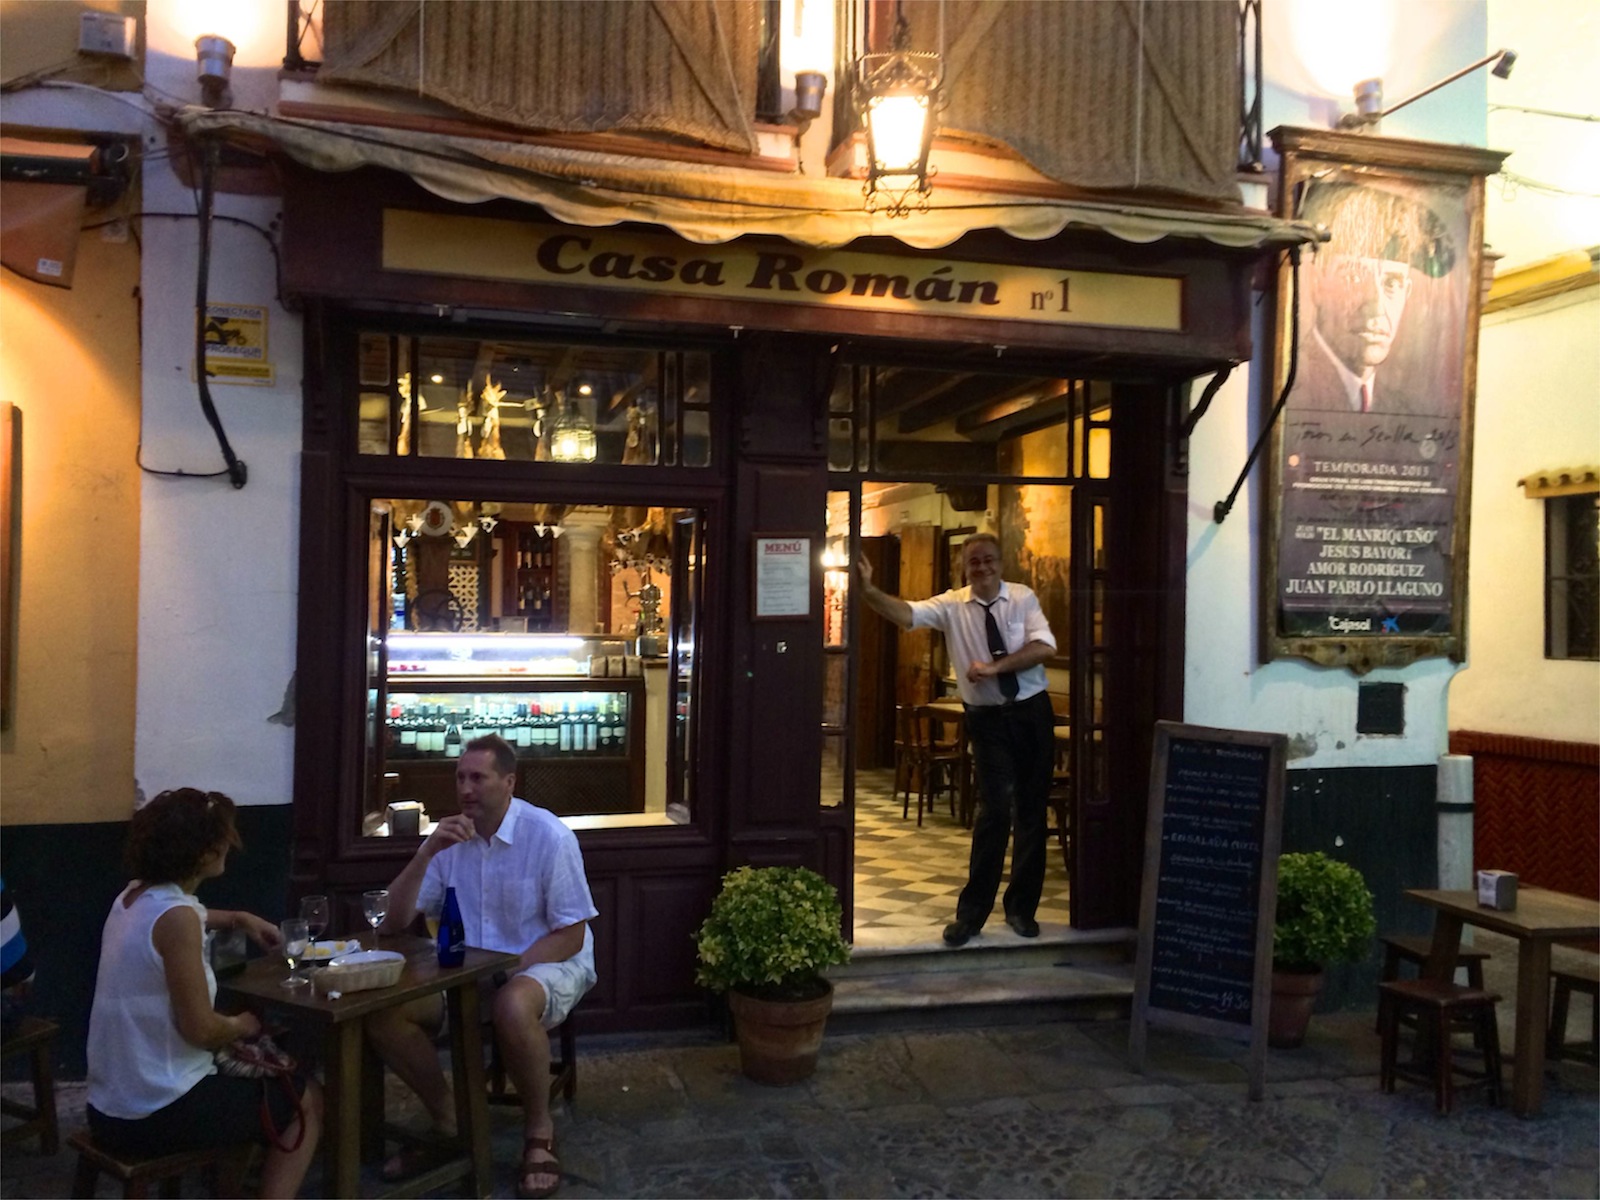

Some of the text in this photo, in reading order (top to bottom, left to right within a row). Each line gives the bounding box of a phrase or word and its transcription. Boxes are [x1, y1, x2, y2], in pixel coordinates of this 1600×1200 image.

[536, 234, 725, 286] Casa
[745, 252, 1001, 305] Román
[1313, 460, 1429, 477] TEMPORADA 2013
[764, 540, 801, 552] MENÚ
[1306, 562, 1347, 576] AMOR
[1286, 578, 1443, 597] JUAN PABLO LLAGUNO
